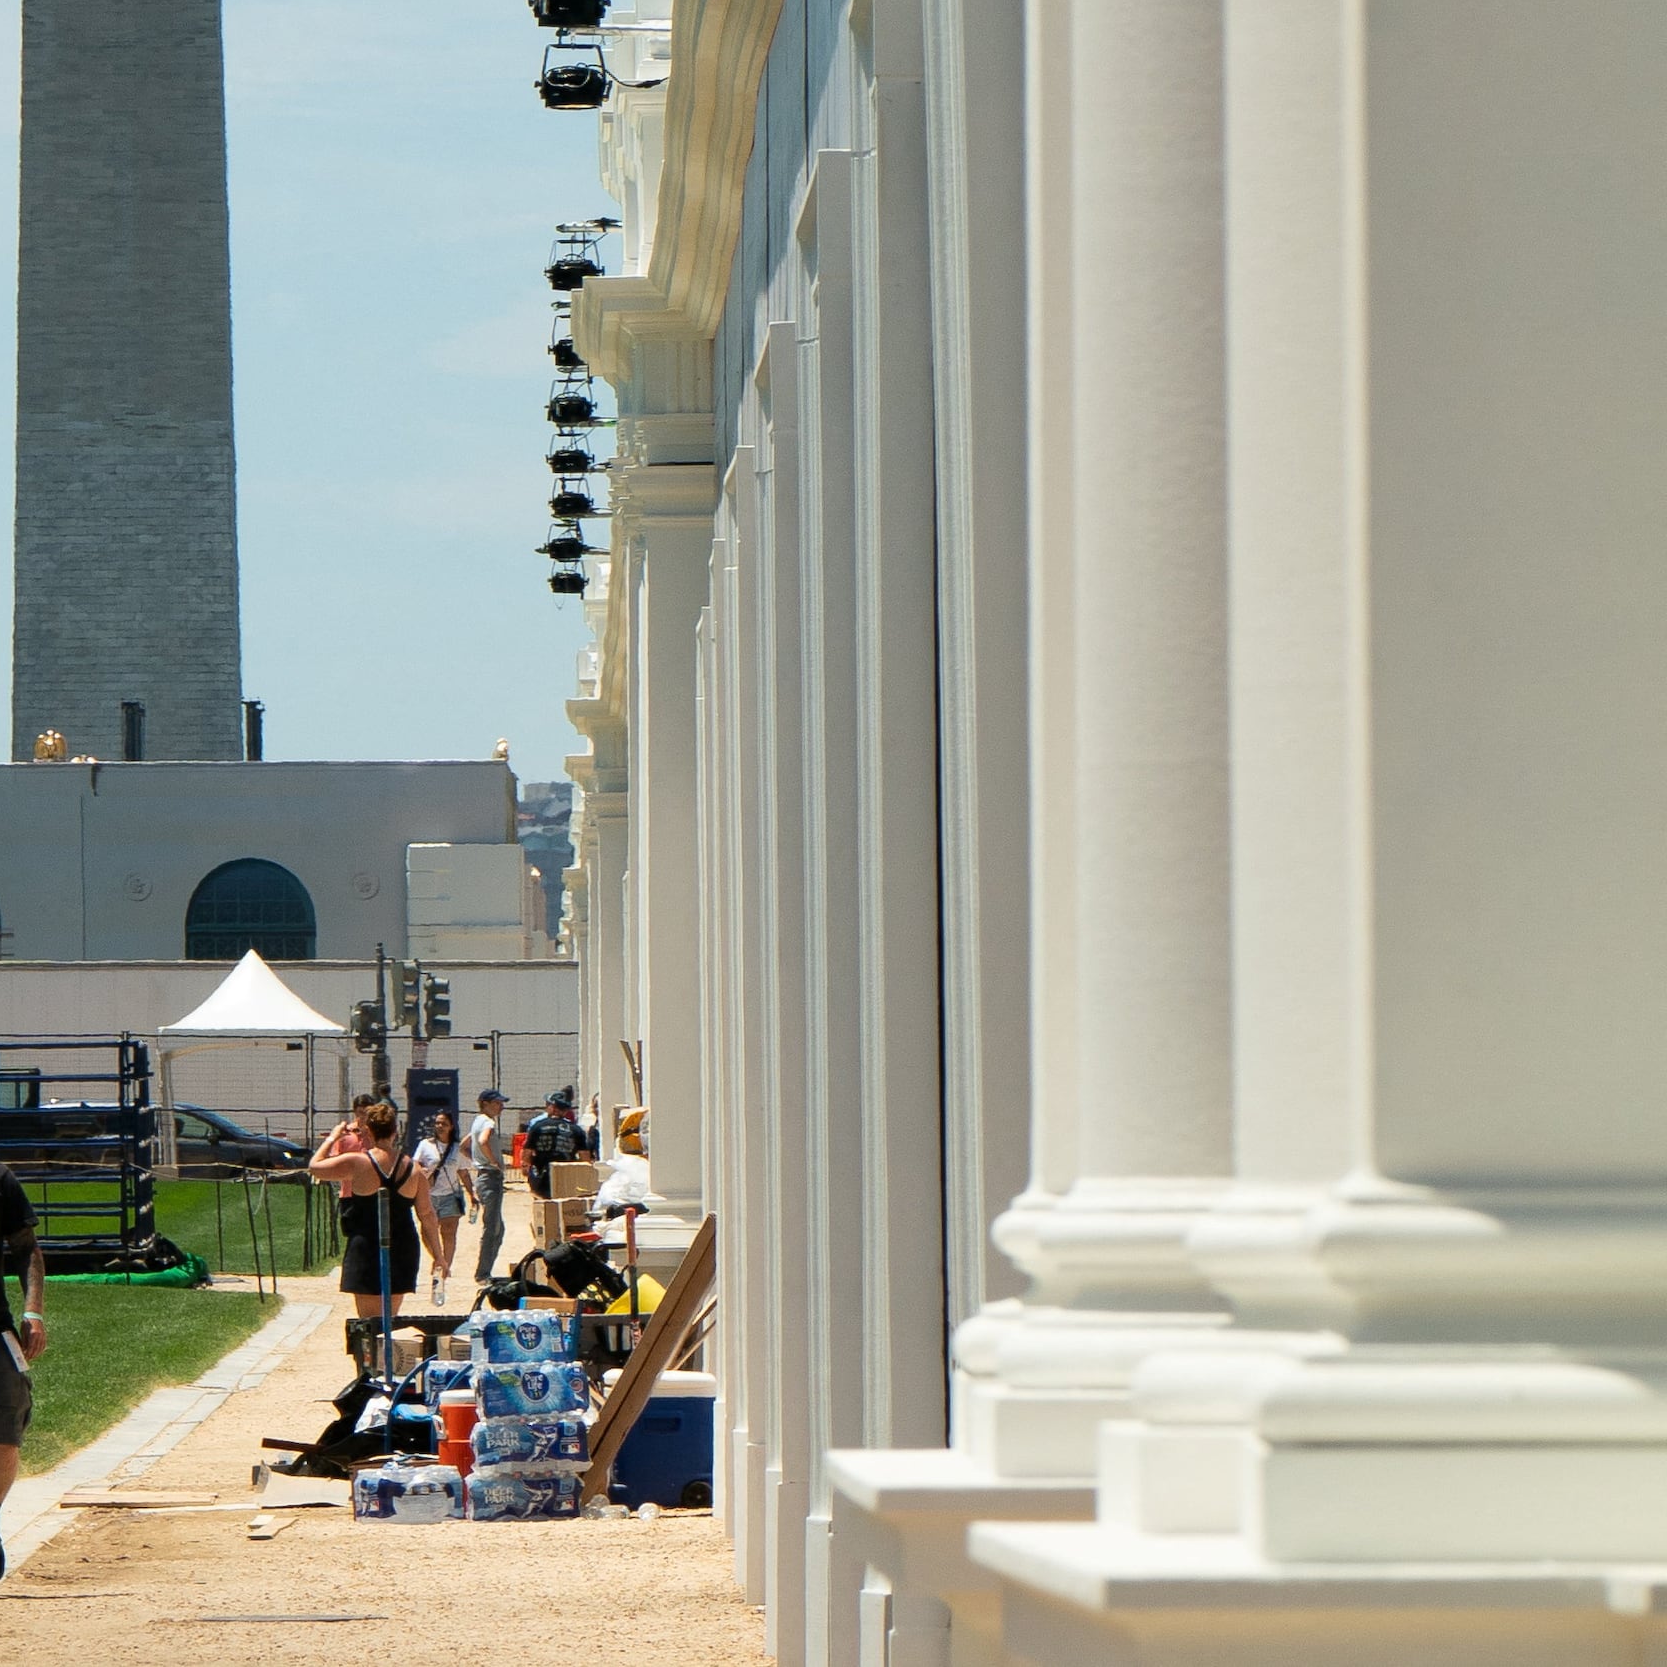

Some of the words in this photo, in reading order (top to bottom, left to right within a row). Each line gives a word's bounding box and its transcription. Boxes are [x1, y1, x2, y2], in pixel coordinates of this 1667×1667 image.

[519, 1325, 537, 1333] Pure
[521, 1332, 537, 1341] Life
[524, 1373, 544, 1382] Pure
[527, 1381, 543, 1391] Life
[485, 1430, 519, 1440] DEER
[486, 1438, 521, 1448] PARK
[483, 1487, 515, 1496] DEER
[484, 1494, 516, 1504] PARK
